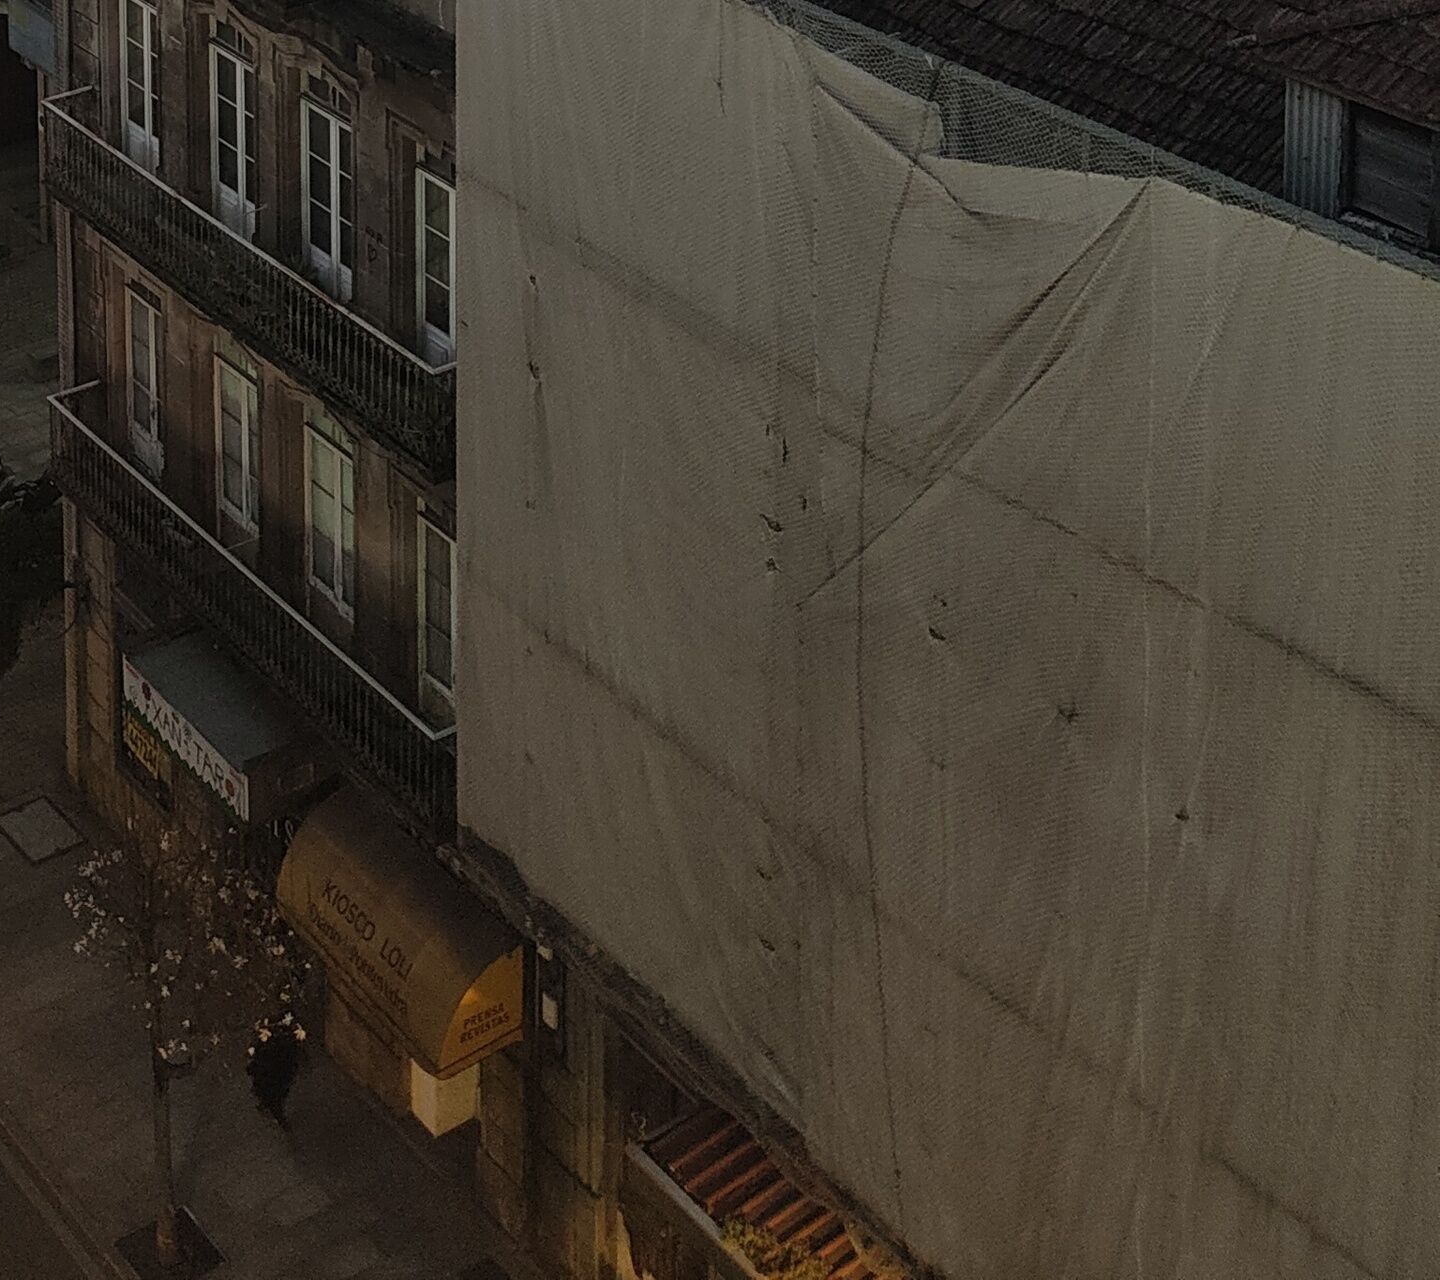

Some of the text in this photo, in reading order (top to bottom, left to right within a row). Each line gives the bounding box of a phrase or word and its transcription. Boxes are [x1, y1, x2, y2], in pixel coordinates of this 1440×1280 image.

[322, 879, 414, 981] KIOSCO LOLI
[460, 1013, 510, 1044] REVISTAS
[464, 1002, 504, 1029] PRENSA
